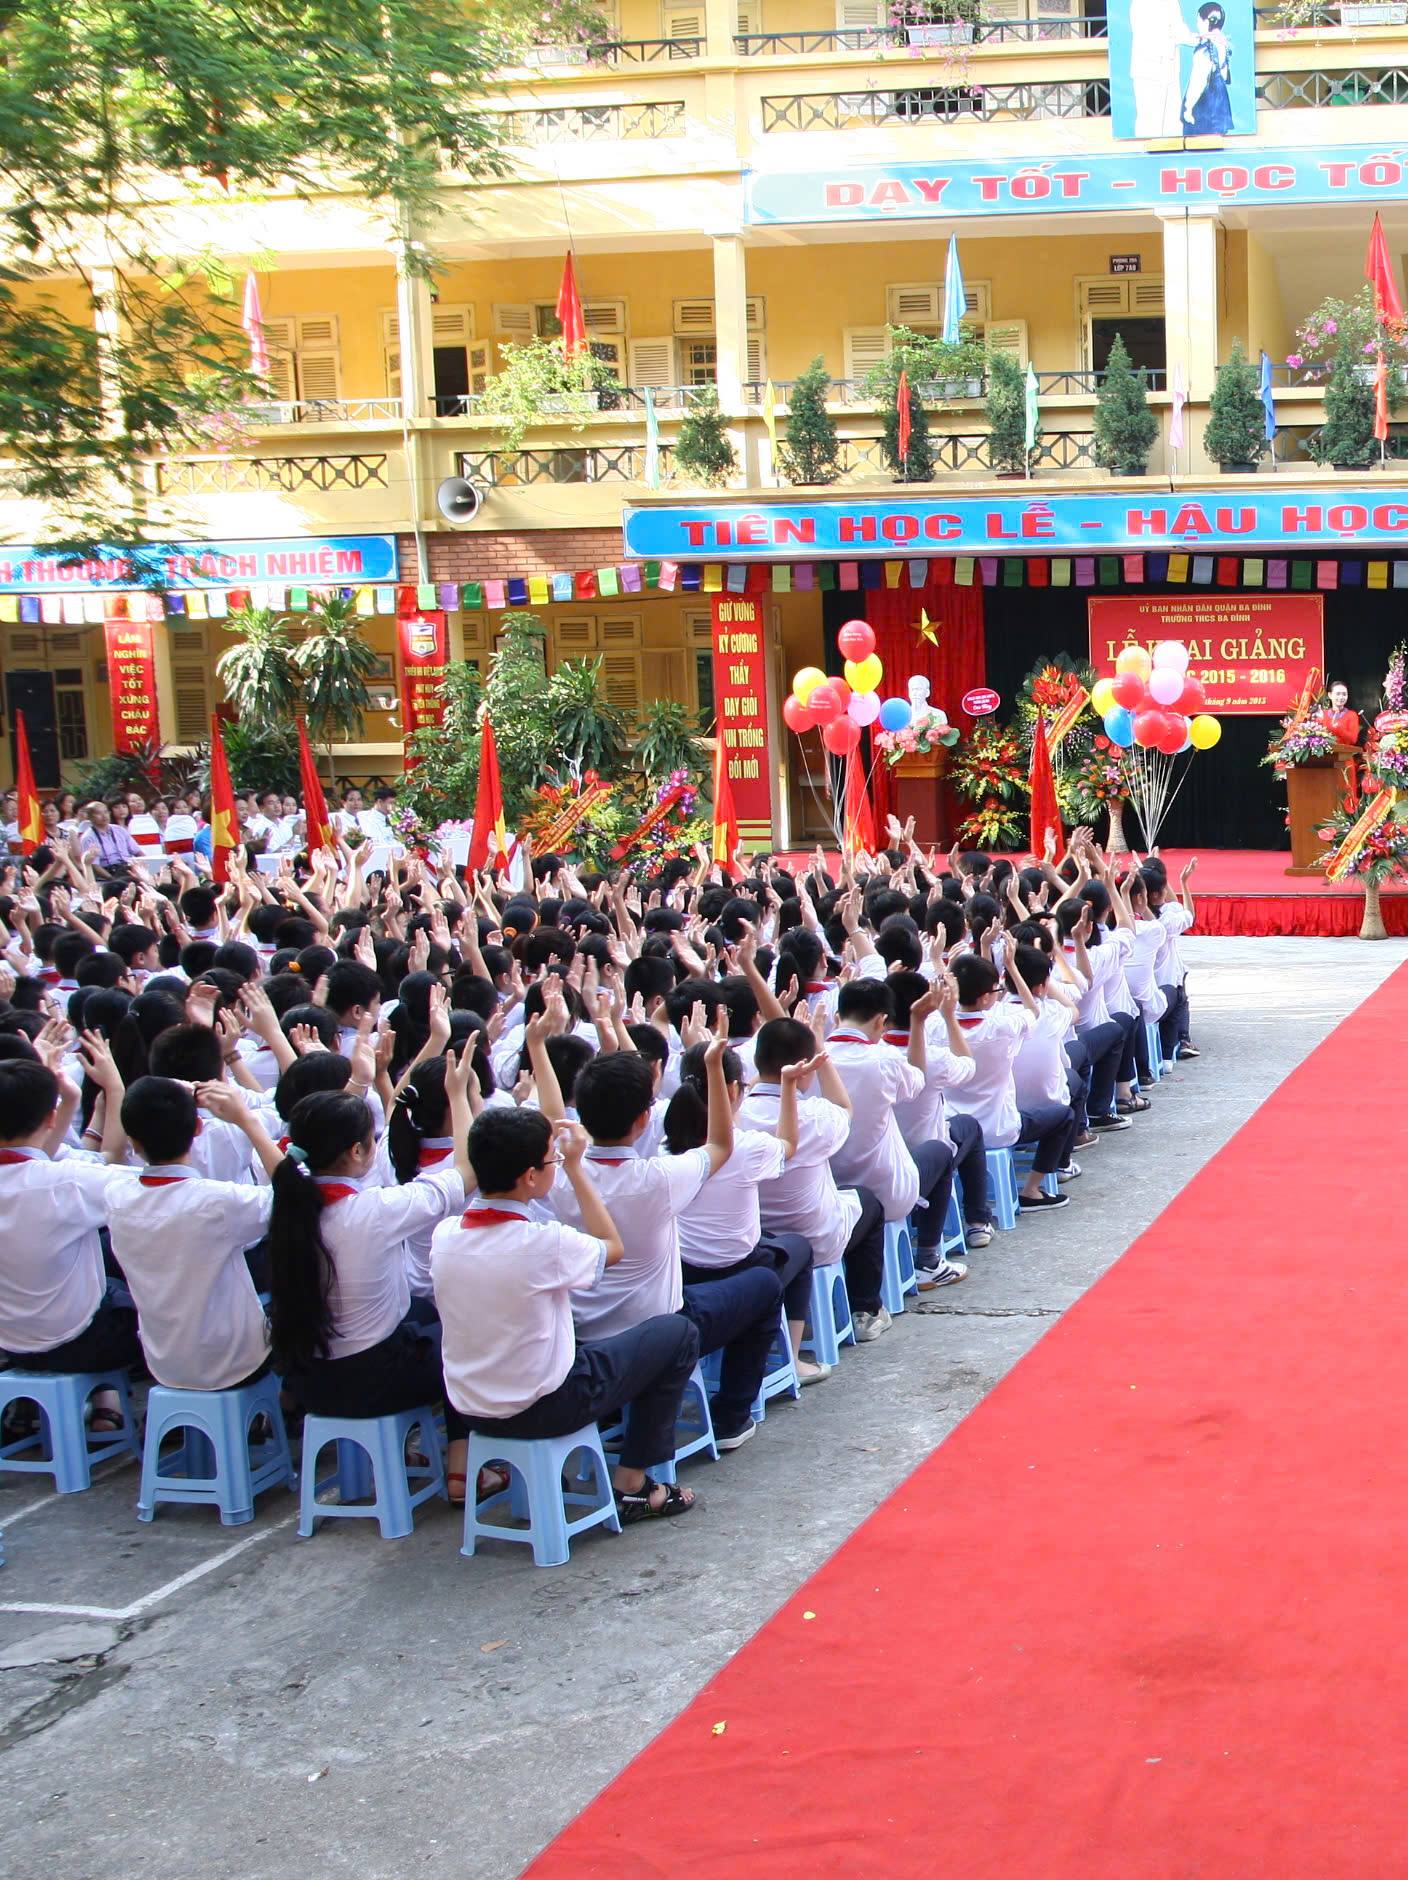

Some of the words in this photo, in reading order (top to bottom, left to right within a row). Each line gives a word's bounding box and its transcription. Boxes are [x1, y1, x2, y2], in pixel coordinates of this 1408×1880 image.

[826, 179, 952, 211] DẠY
[972, 164, 1089, 200] TỐT
[1161, 165, 1296, 197] HỌC
[681, 514, 815, 546] TIÊN
[840, 513, 962, 546] HỌC
[986, 502, 1056, 539] LỄ
[1127, 503, 1257, 540] HẬU
[267, 546, 363, 578] NHIỆM
[718, 598, 732, 622] GIỮ
[733, 598, 755, 622] VỮNG
[1152, 605, 1169, 613] BAN
[1170, 604, 1194, 612] NHÂN
[1195, 603, 1212, 612] DÂN
[1214, 603, 1237, 613] QUẬN
[1252, 602, 1272, 611] ĐÌNH
[1160, 613, 1193, 623] TRƯỜNG
[1194, 614, 1216, 623] THCS
[1217, 614, 1229, 622] BA
[1230, 613, 1251, 622] ĐÌNH
[730, 632, 758, 653] CƯƠNG
[1220, 628, 1306, 660] GIẢNG
[119, 664, 145, 676] VIỆC
[1200, 669, 1236, 684] 2015
[1250, 668, 1286, 684] 2016
[121, 677, 143, 689] TỐT
[119, 693, 150, 705] XỨNG
[724, 697, 740, 721] DẠY
[741, 688, 758, 716] GIỎI
[1226, 697, 1231, 705] 9
[1231, 697, 1248, 705] năm
[1248, 697, 1267, 705] 2015
[121, 709, 150, 720] CHÁU
[125, 724, 147, 735] BÁC
[743, 753, 760, 779] MỚI
